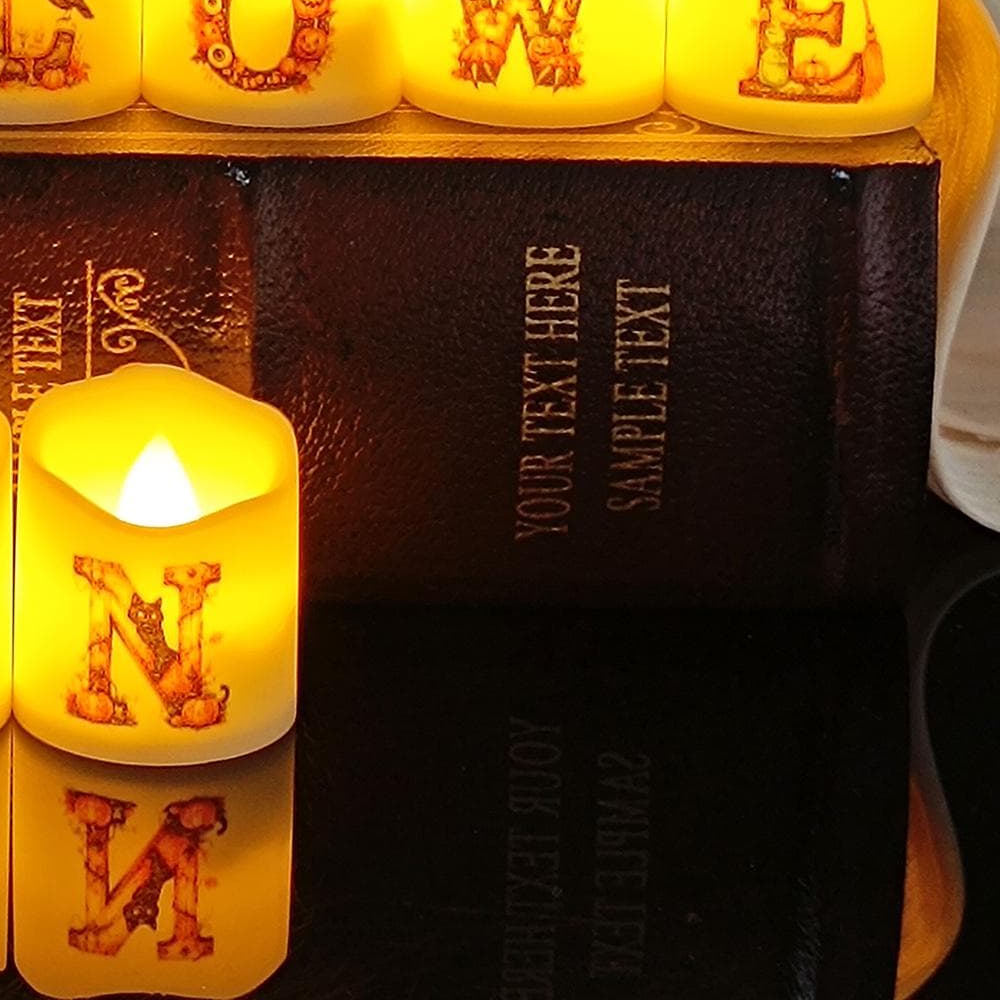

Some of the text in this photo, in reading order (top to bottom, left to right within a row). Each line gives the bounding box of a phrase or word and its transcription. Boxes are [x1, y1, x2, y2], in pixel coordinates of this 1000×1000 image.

[12, 291, 63, 374] TEXT
[514, 244, 582, 541] YOUR TEXT HERE
[605, 278, 672, 512] SAMPLE TEXT
